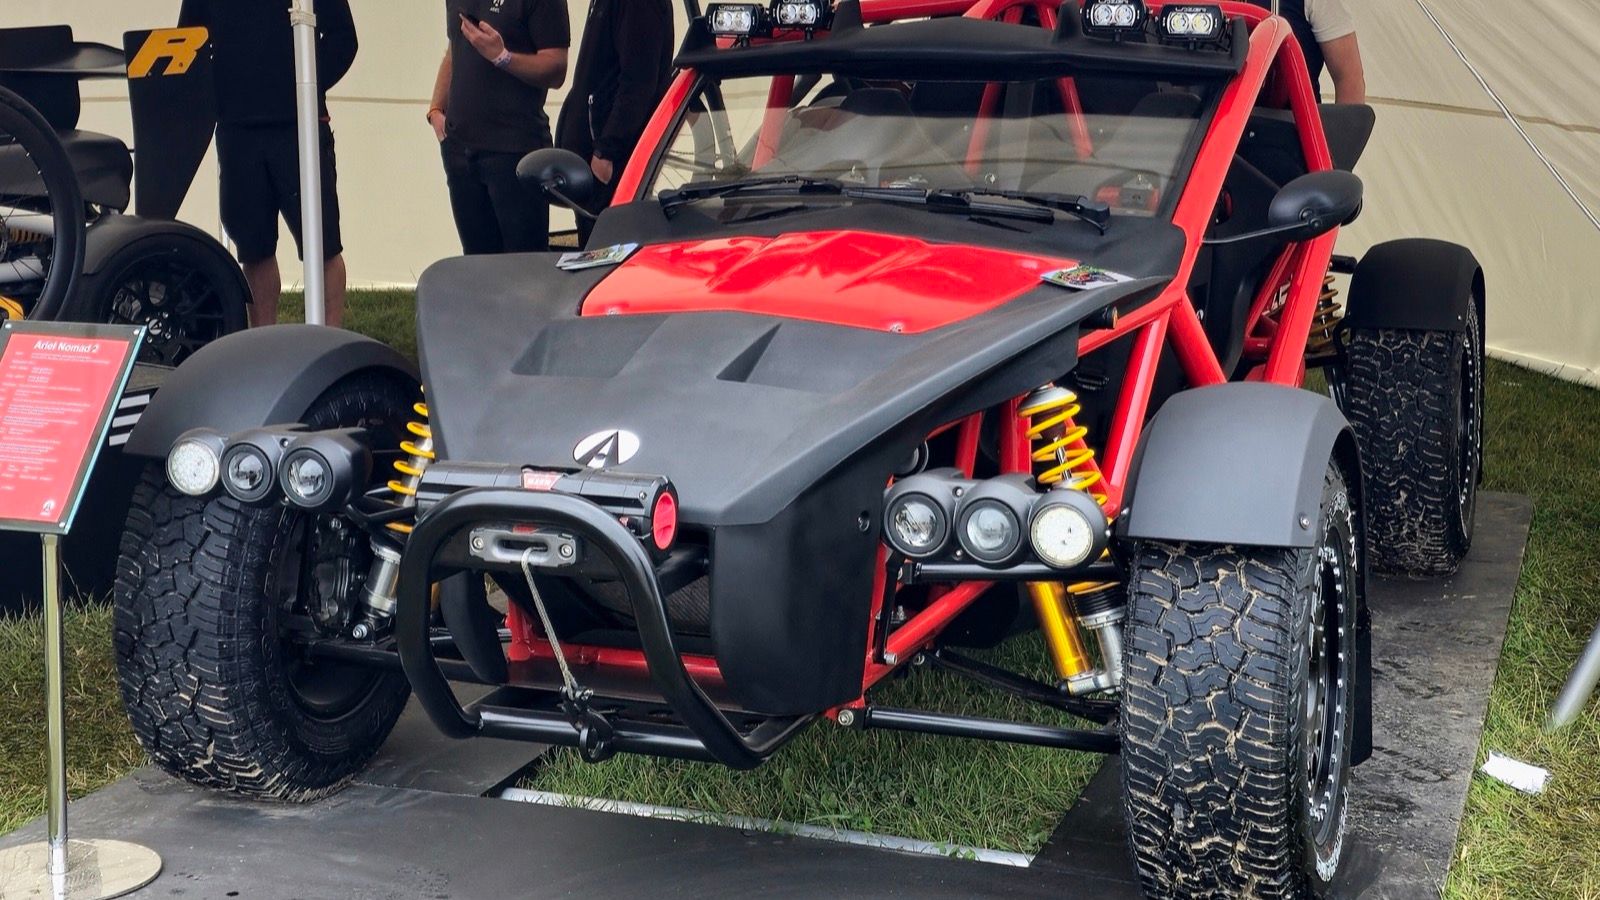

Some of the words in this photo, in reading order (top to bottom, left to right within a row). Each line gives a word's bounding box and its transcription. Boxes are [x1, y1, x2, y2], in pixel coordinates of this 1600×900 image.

[33, 340, 57, 351] Ariel
[58, 342, 91, 352] Nomad
[91, 344, 99, 353] 2
